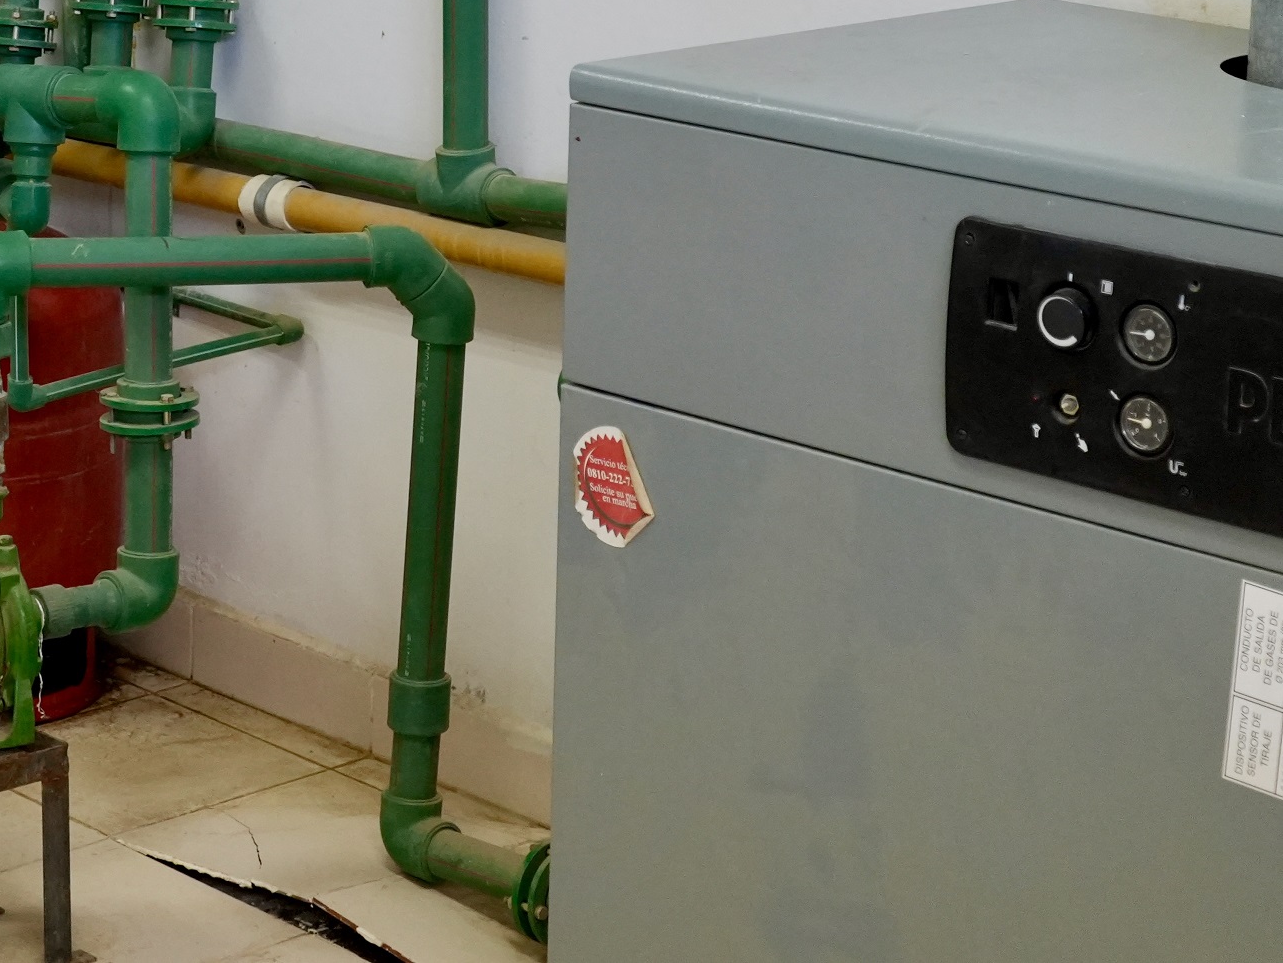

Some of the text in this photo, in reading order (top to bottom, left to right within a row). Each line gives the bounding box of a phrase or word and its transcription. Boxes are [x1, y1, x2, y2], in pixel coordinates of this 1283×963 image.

[587, 467, 634, 487] 0810-222-7
[589, 455, 616, 469] Servicio
[589, 482, 615, 496] Solicite
[616, 490, 624, 498] su
[602, 495, 637, 510] en marcha
[1239, 608, 1255, 672] CONDUCTO
[1251, 615, 1266, 673] DE SALIDA
[1262, 610, 1279, 686] DE GASES DE
[1234, 705, 1250, 776] DISPOSITIVO
[1246, 712, 1261, 777] SENSOR DE
[1259, 729, 1273, 767] TIRAJE
